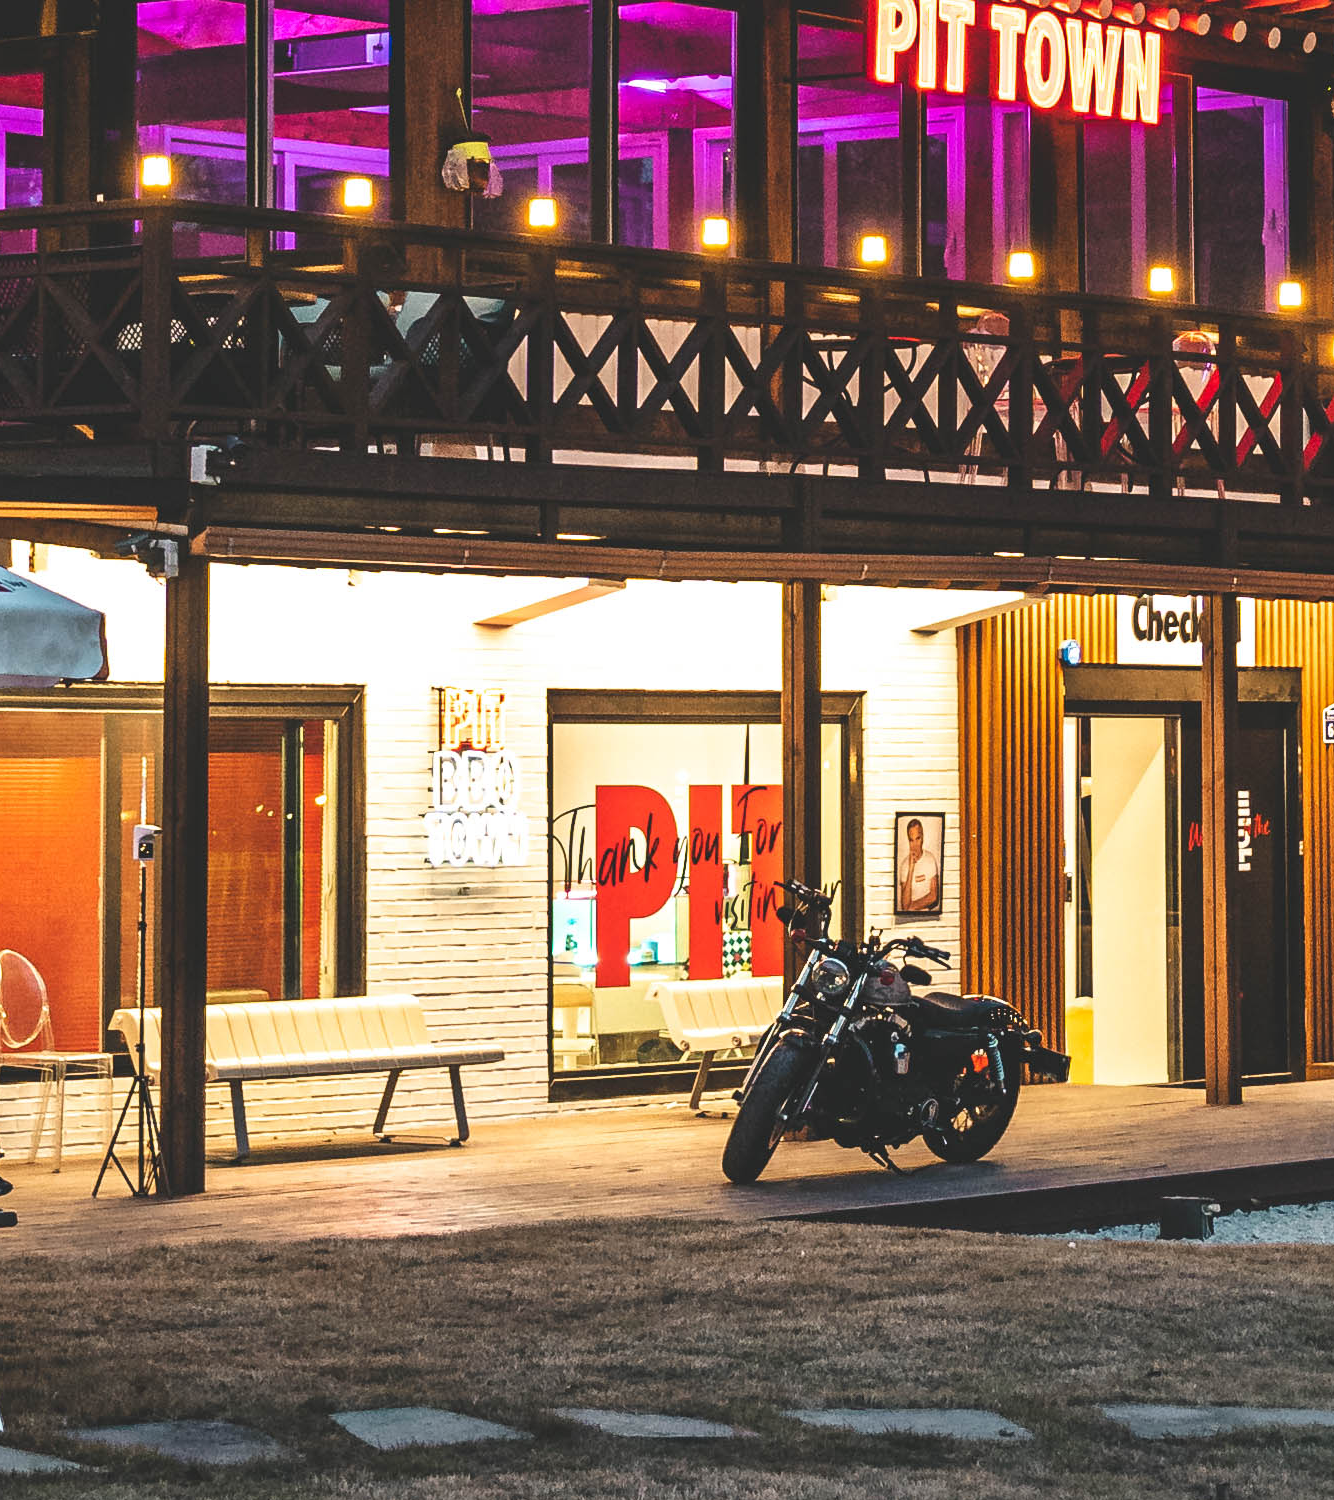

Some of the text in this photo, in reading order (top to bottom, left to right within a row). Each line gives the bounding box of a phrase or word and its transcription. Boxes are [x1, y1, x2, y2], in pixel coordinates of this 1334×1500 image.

[989, 3, 1162, 125] TOWN
[441, 686, 506, 750] PIT
[432, 750, 518, 812] BBQ
[552, 804, 660, 893] Thank
[673, 826, 719, 896] you
[595, 784, 784, 988] PIT
[715, 871, 784, 931] visitin
